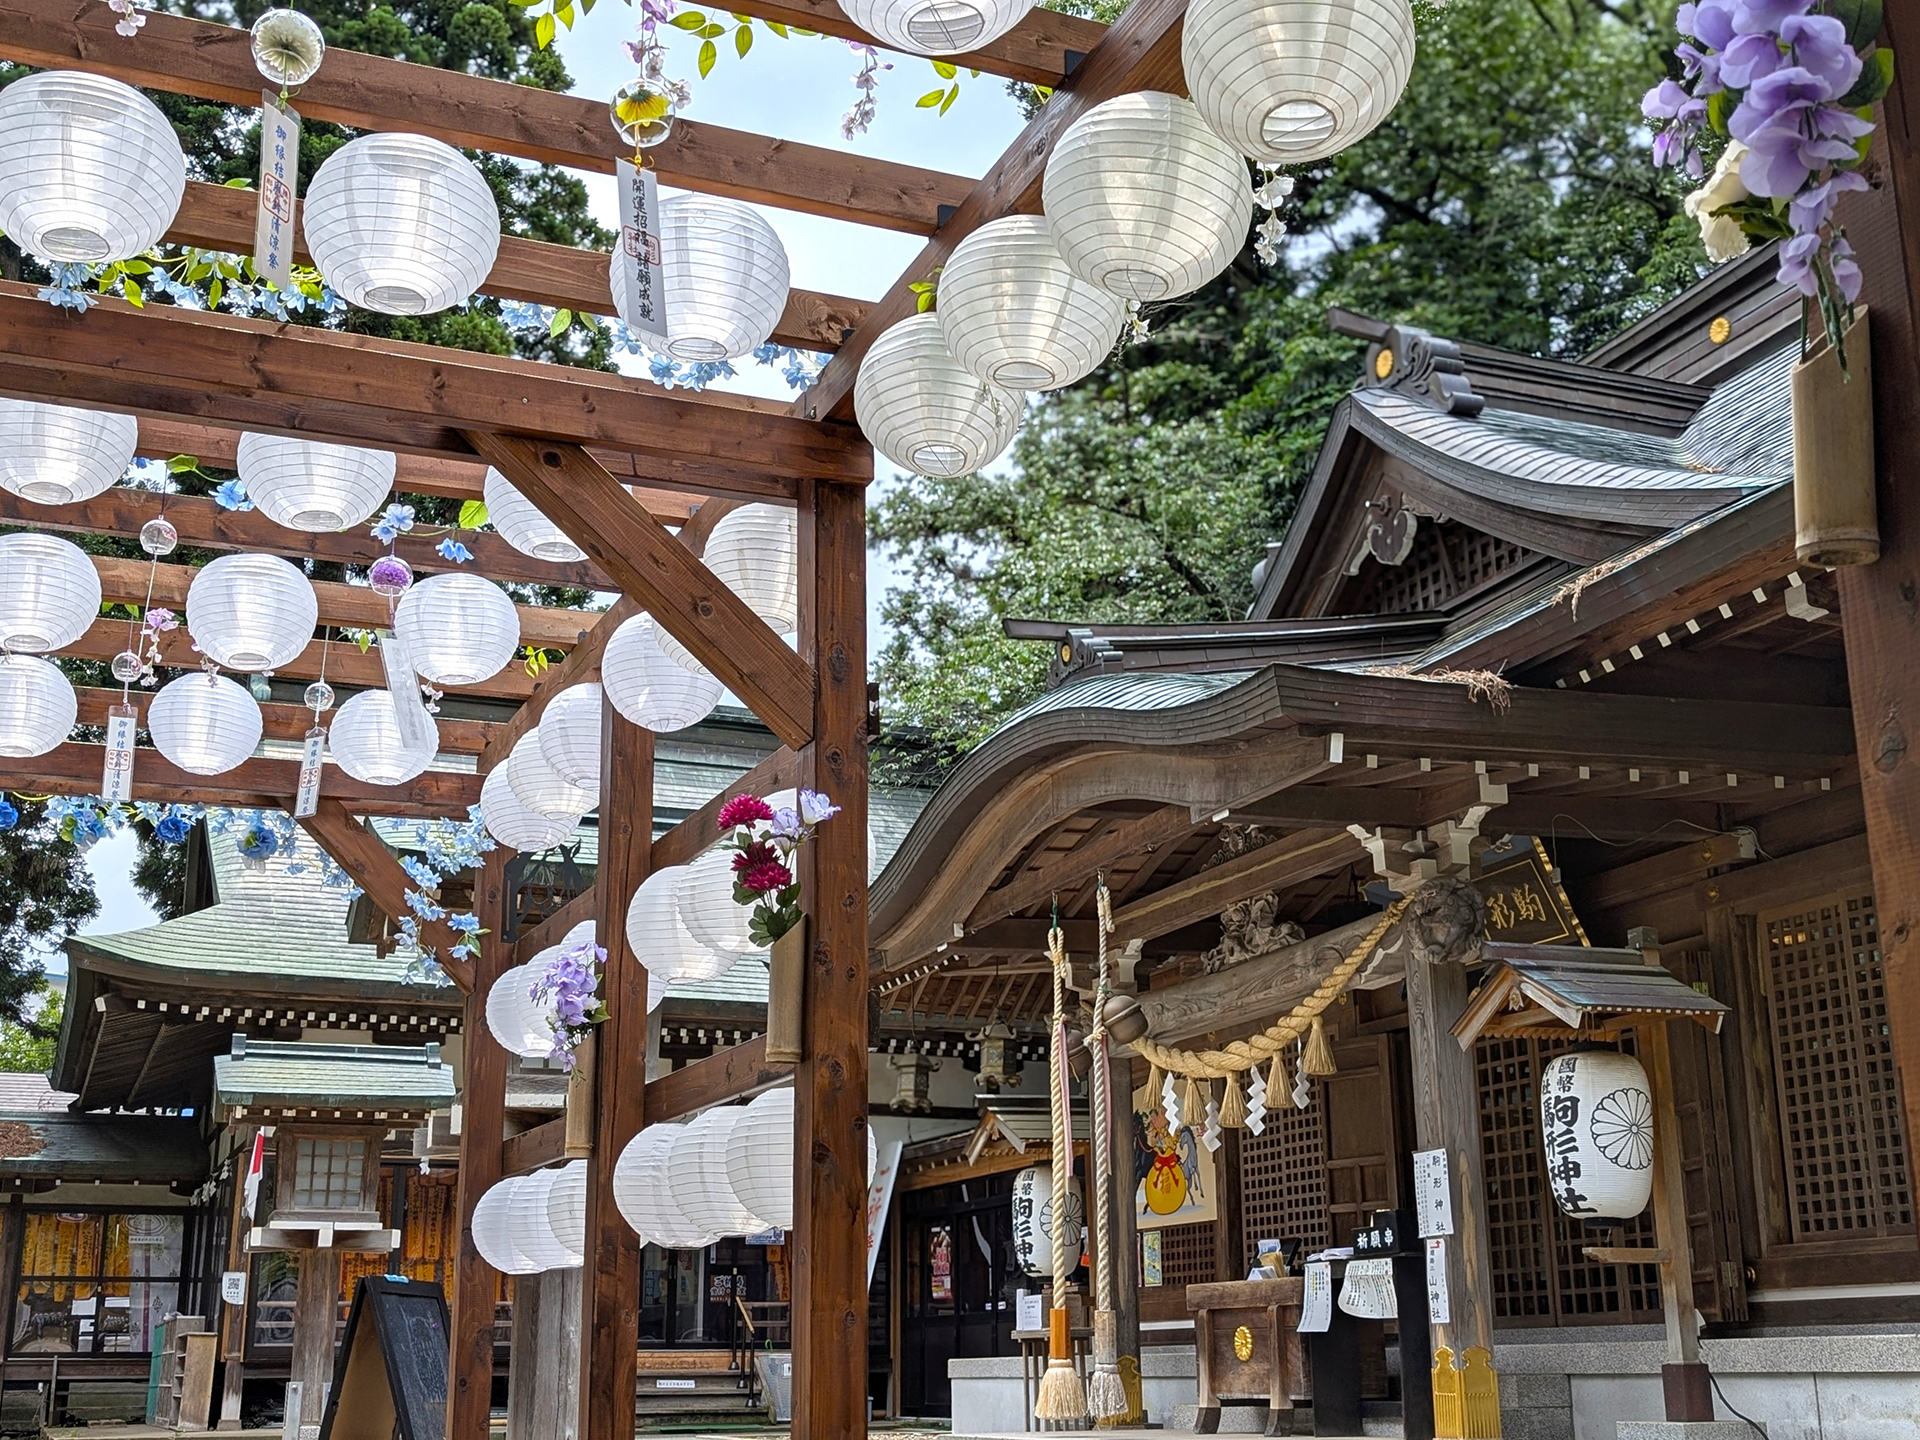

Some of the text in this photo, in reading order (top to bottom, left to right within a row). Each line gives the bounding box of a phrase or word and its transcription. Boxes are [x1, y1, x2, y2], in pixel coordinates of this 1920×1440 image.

[631, 178, 655, 322] 開運招福諸願成就
[1159, 1172, 1172, 1195] 福
[1541, 1094, 1598, 1214] 駒形神社
[1432, 1155, 1446, 1232] 駒形神社
[1356, 1226, 1394, 1250] 祈願串
[1429, 1275, 1441, 1319] 山神社
